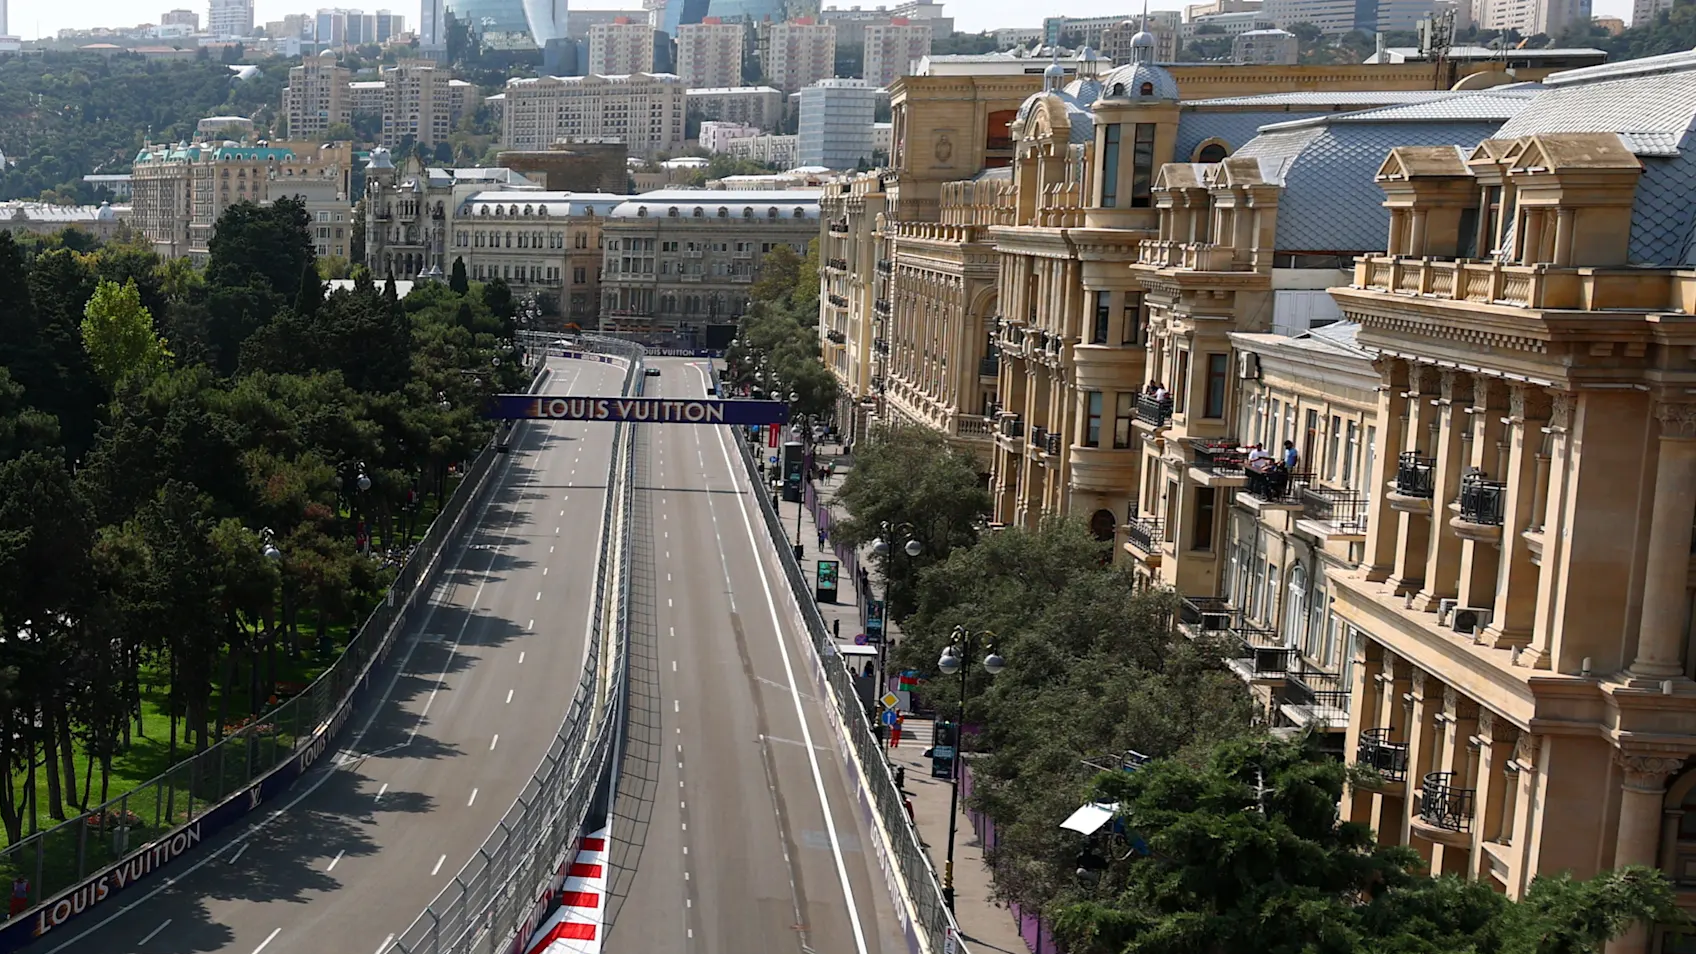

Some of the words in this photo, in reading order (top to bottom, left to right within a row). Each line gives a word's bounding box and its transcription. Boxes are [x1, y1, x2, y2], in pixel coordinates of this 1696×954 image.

[537, 398, 610, 420] LOUIS
[617, 399, 724, 422] VUITTON
[300, 732, 326, 773] LOUIS
[39, 879, 109, 936] LOUIS
[114, 821, 202, 889] VUITTON
[520, 889, 549, 953] LOUIS
